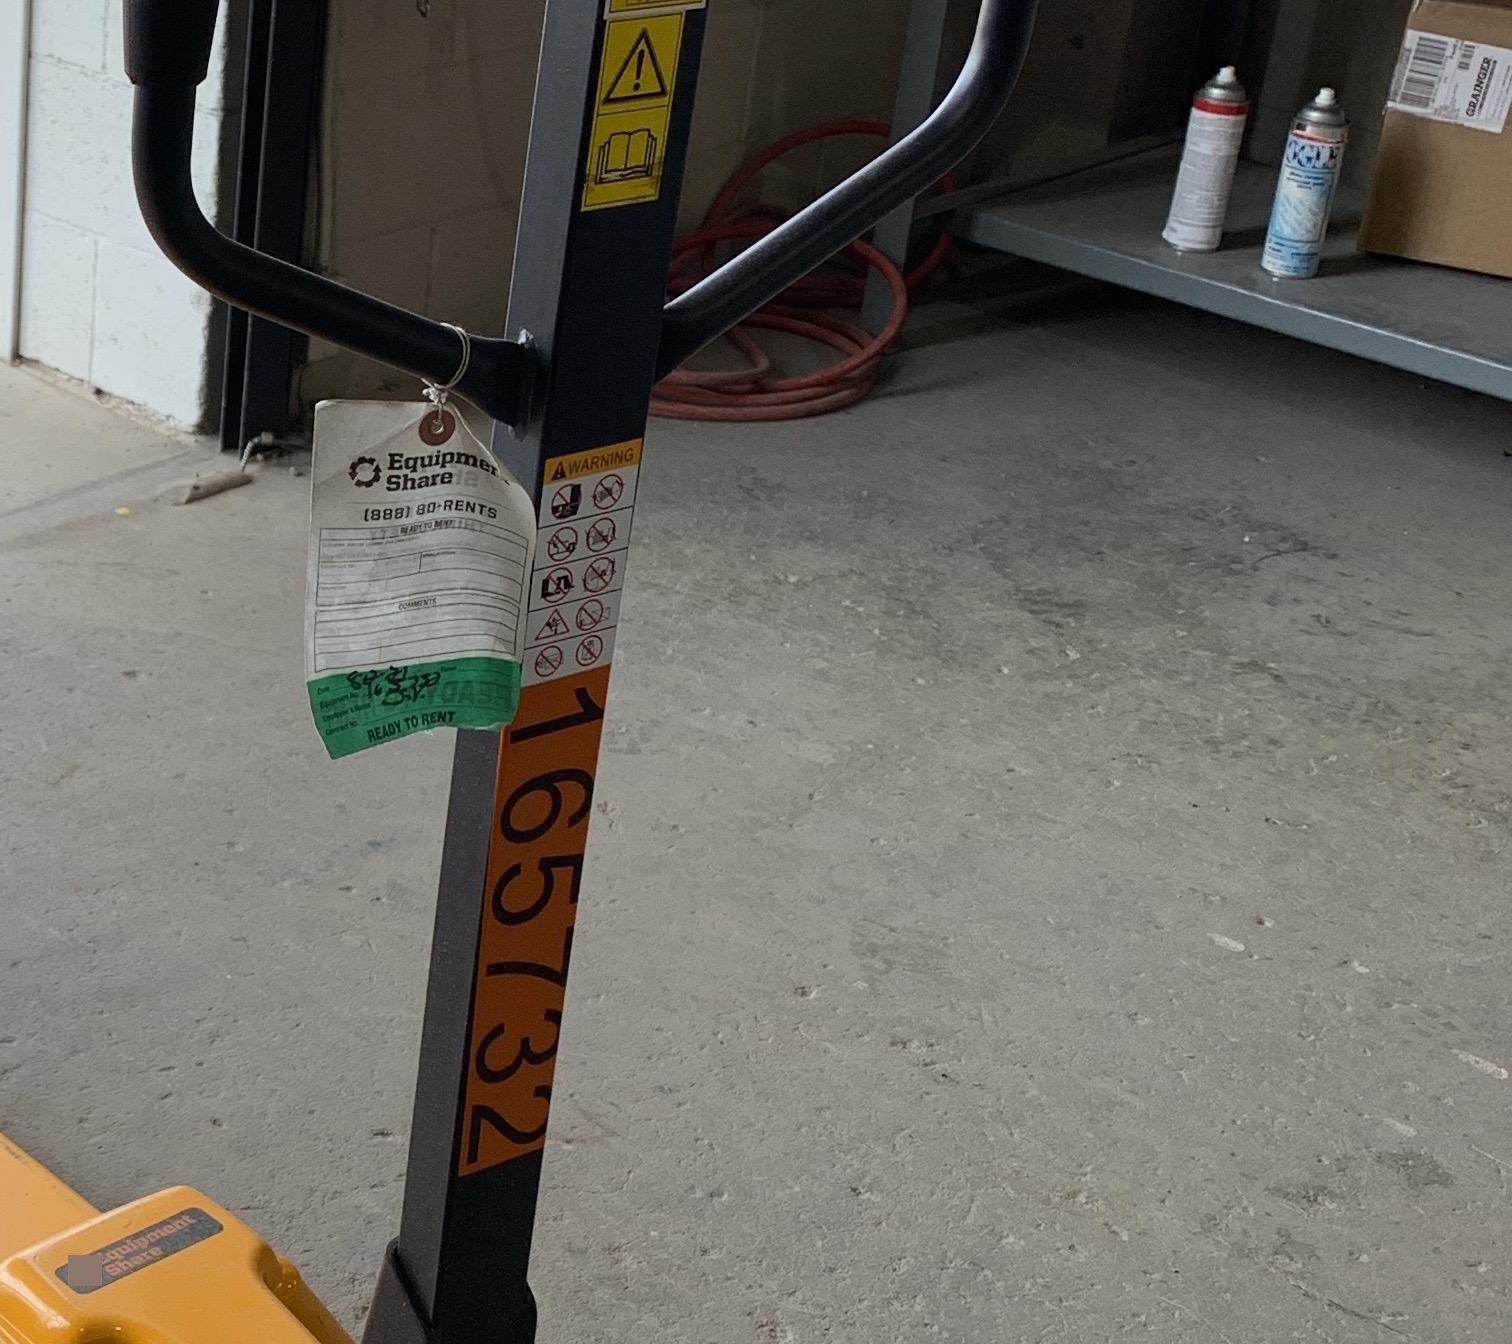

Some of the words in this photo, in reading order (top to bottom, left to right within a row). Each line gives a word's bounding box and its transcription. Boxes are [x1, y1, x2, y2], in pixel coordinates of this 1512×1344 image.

[1465, 57, 1493, 118] GRAINGER
[568, 447, 634, 476] WARNING
[386, 471, 453, 492] Share
[364, 506, 411, 522] (888)
[416, 499, 499, 520] 80-RENTS
[398, 598, 437, 611] COMMENTS
[367, 725, 403, 743] READY
[405, 717, 420, 729] TO
[421, 711, 457, 726] RENT
[105, 1247, 164, 1277] Share
